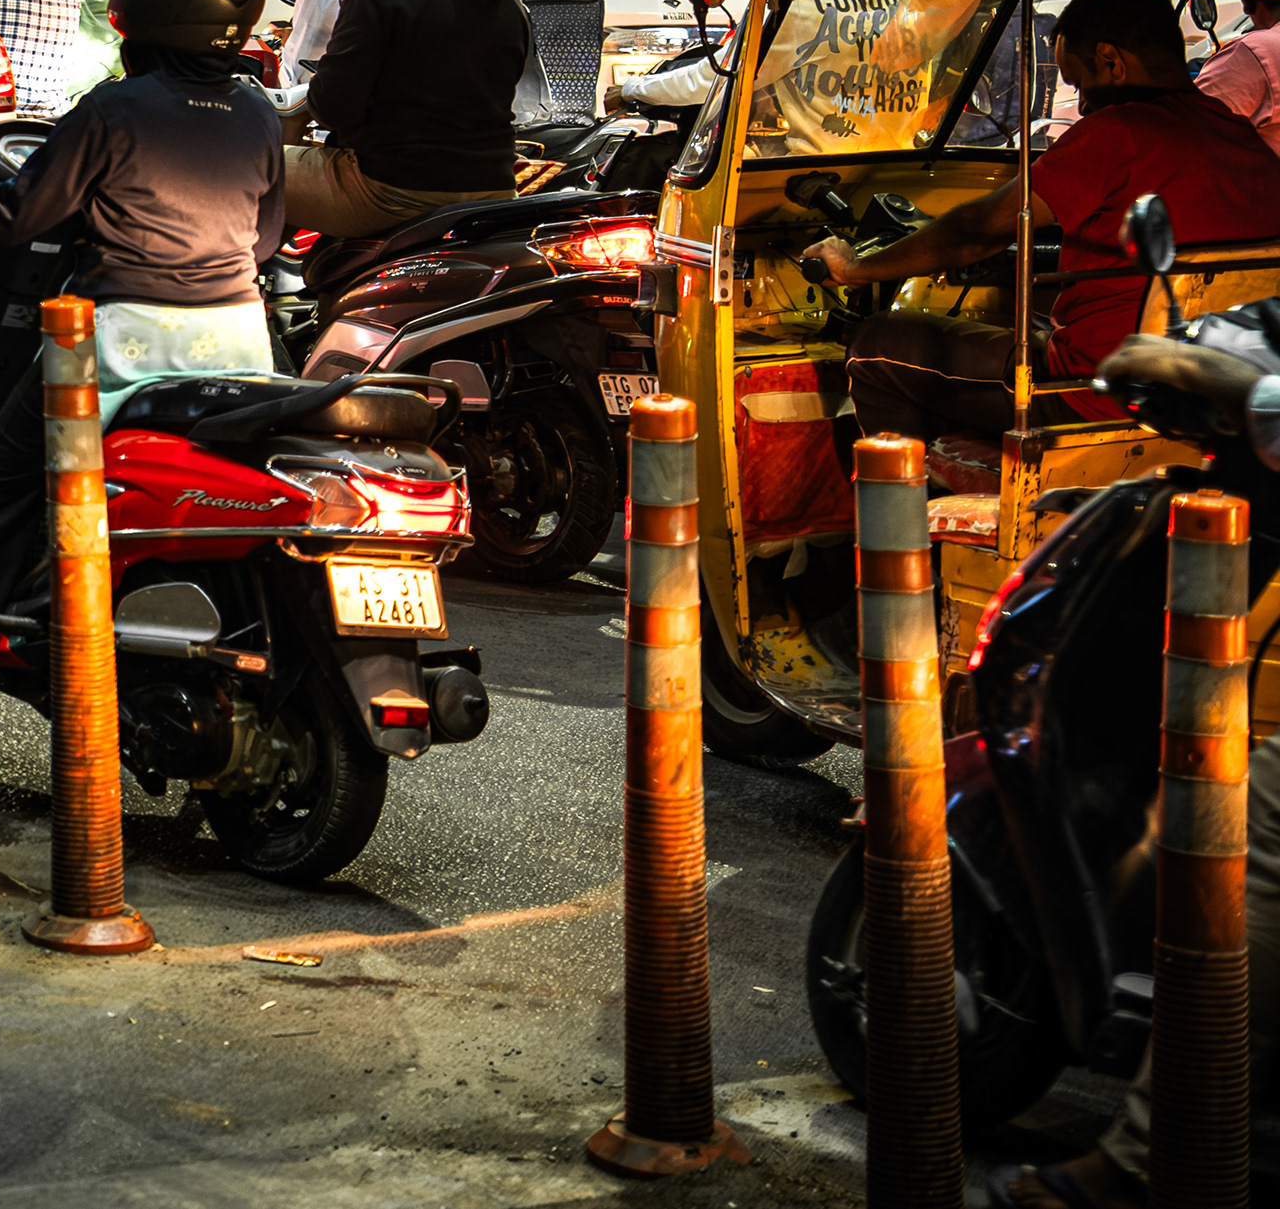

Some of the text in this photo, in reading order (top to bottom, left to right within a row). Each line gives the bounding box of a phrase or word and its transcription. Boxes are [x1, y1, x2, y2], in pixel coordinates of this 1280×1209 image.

[188, 99, 212, 108] BLUE
[609, 376, 631, 394] TG
[397, 572, 421, 598] 31
[364, 598, 427, 626] A2481
